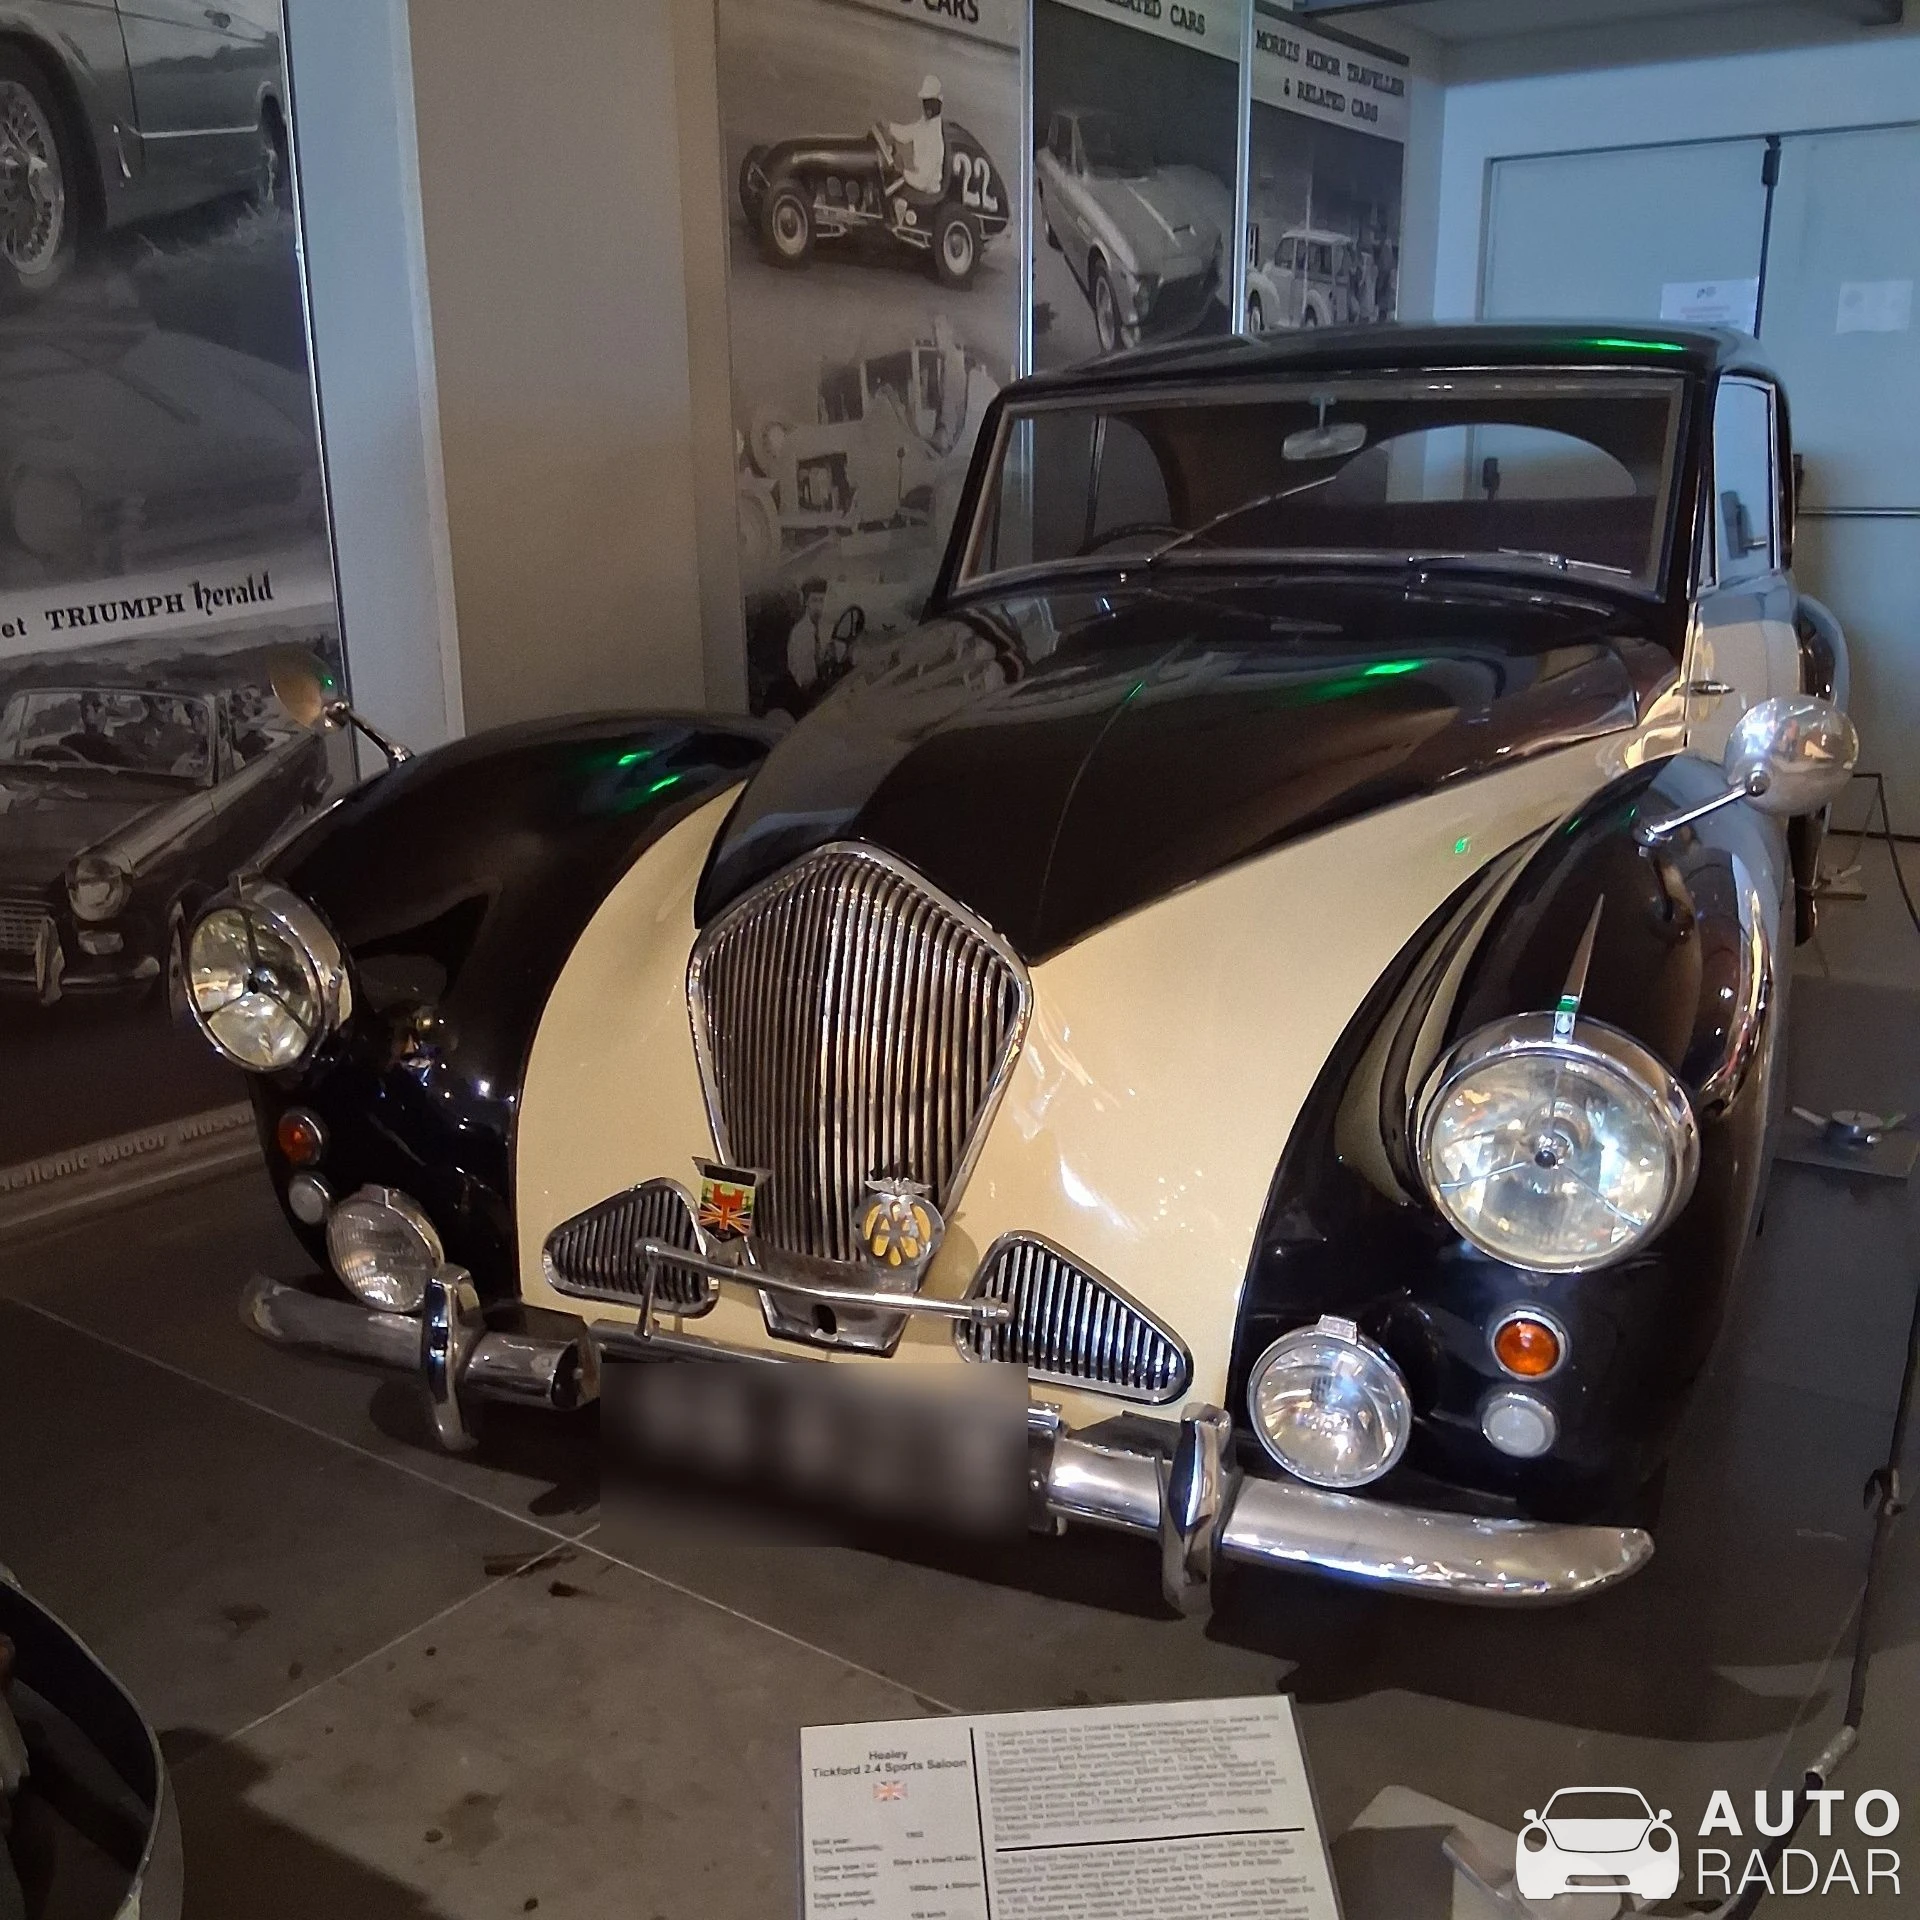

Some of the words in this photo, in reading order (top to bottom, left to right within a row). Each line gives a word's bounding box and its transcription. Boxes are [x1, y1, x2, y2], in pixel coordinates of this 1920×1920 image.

[1170, 4, 1205, 35] CARS
[1256, 29, 1300, 62] MORRIS
[1306, 49, 1341, 77] MINOR
[1297, 80, 1346, 112] RELATED
[1352, 98, 1378, 122] CARS
[952, 152, 999, 213] 22
[45, 592, 185, 632] TRIUMPH
[97, 1132, 165, 1165] Motor
[177, 1110, 256, 1141] Museu
[812, 1765, 861, 1778] Tickford
[864, 1763, 882, 1774] 2.4
[885, 1760, 924, 1774] Sports
[927, 1757, 968, 1770] Saloon
[868, 1750, 908, 1761] Healey
